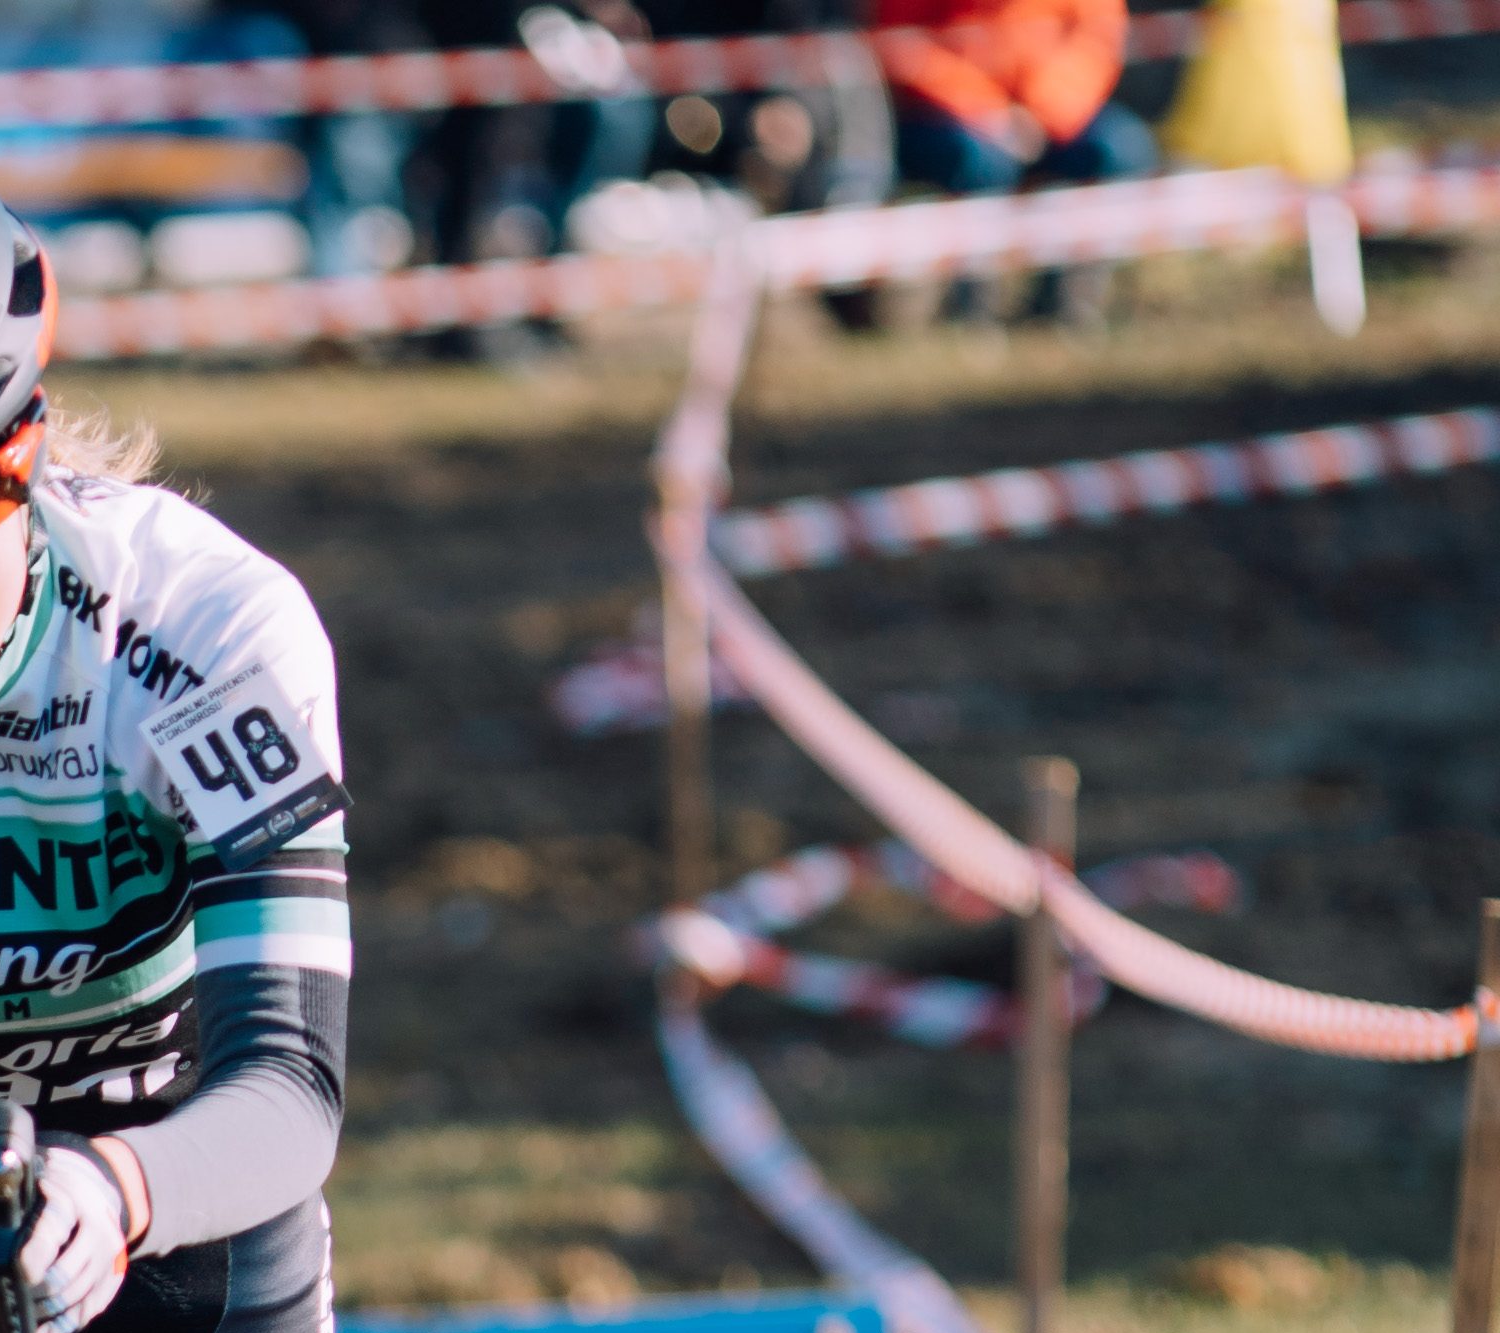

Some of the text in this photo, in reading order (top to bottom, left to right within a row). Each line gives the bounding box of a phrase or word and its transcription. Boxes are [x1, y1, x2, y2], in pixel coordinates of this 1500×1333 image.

[58, 565, 111, 633] BK
[150, 662, 264, 737] NACIONALNO PRVENSTVO
[180, 705, 301, 802] 48
